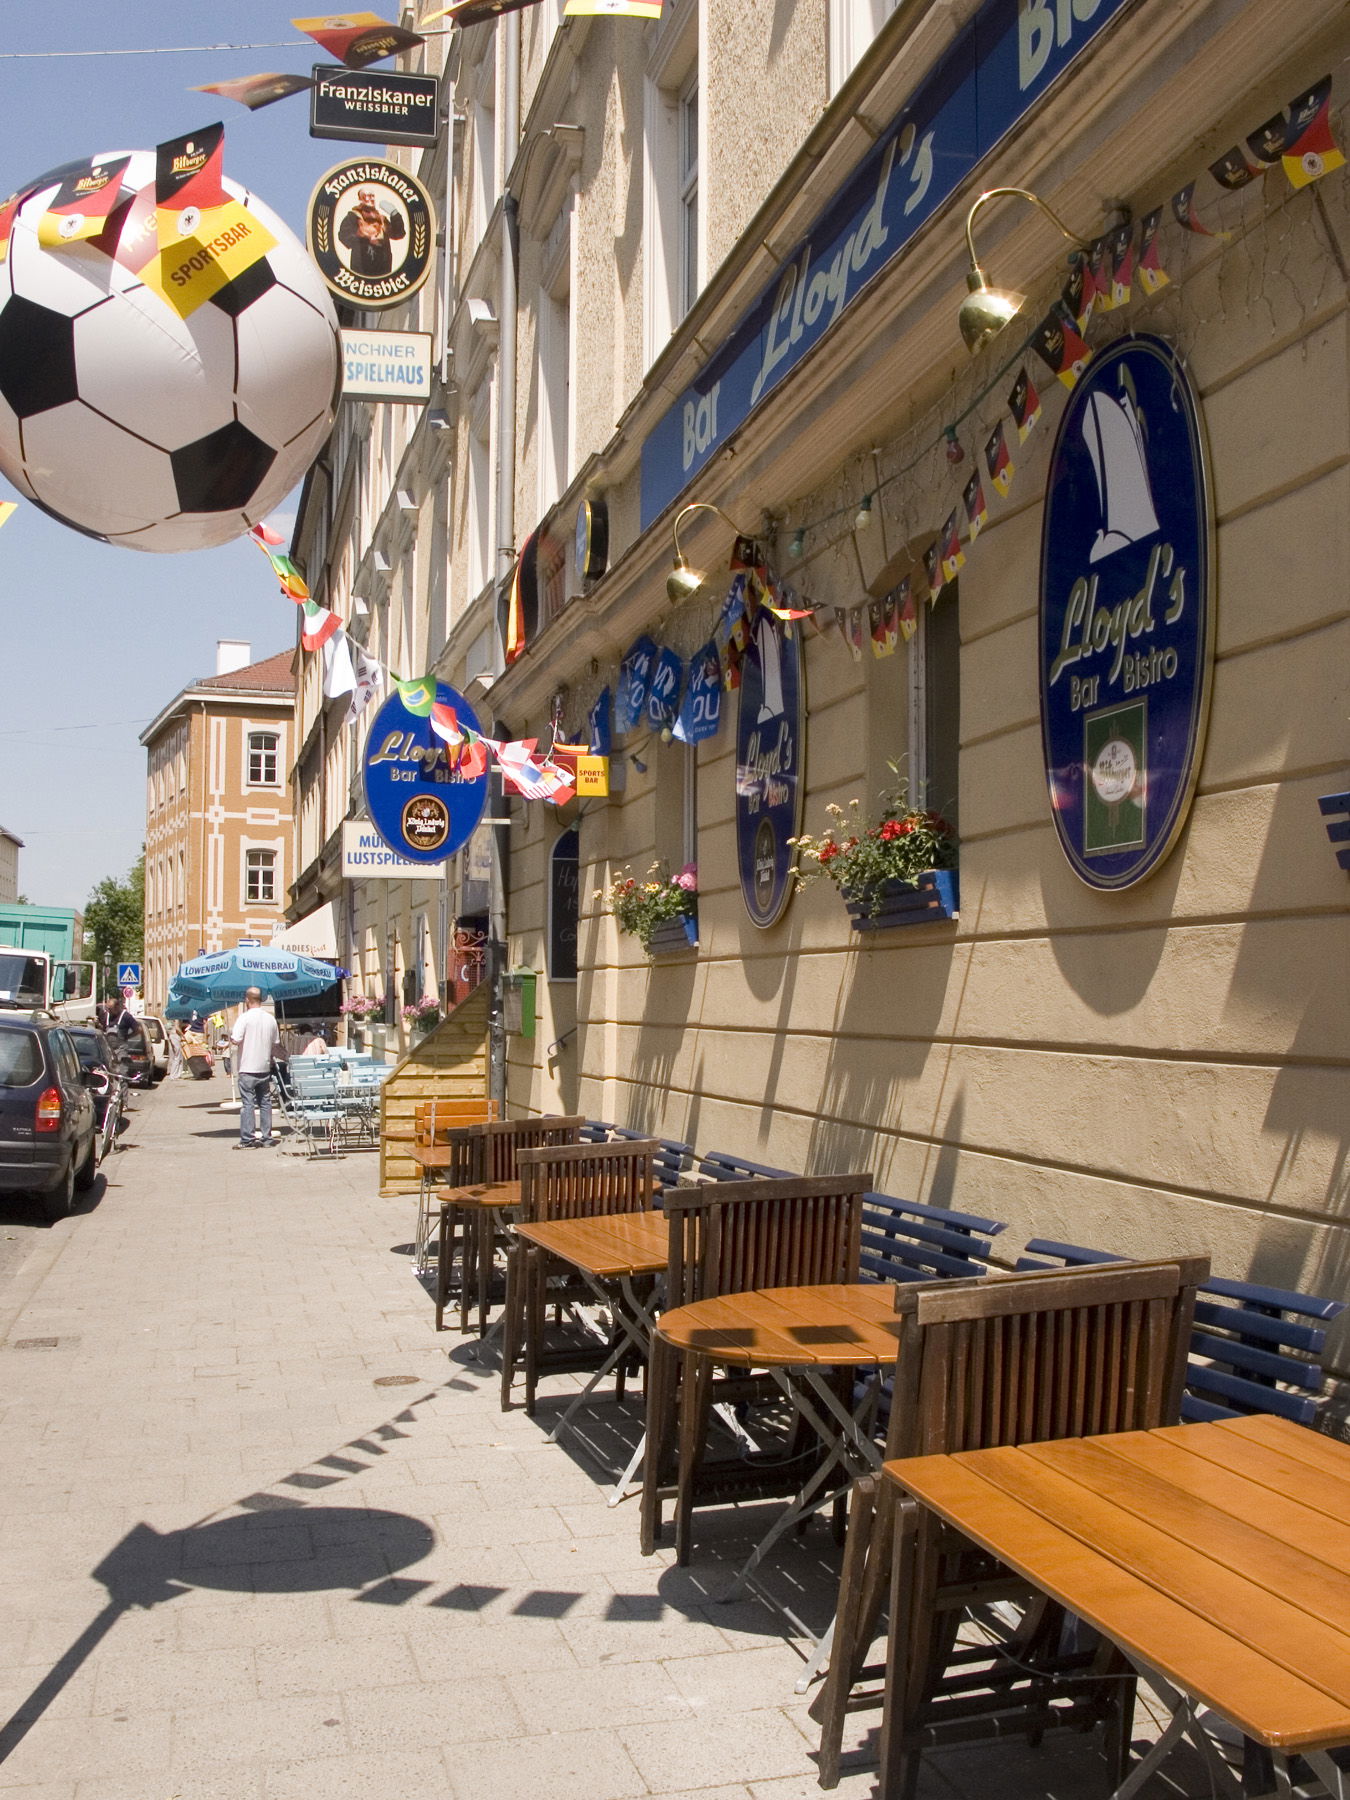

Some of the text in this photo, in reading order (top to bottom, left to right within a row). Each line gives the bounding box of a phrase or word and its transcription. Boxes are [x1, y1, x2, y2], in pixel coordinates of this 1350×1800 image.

[320, 82, 434, 107] Franziskaner
[344, 101, 409, 115] WEISSBIER
[324, 164, 419, 203] Franziskaner
[171, 222, 252, 287] SPORTSBAR
[334, 267, 411, 297] Weissbier
[683, 379, 721, 472] Bar
[751, 122, 934, 406] Lloyd's
[345, 342, 416, 358] NCHNER
[345, 361, 424, 385] SPIELHAUS
[1050, 542, 1186, 687] Lloyd's
[1071, 646, 1178, 713] Bar Bistro
[390, 767, 418, 782] Bar
[578, 769, 605, 777] SPORTS
[584, 776, 599, 784] BAR
[281, 944, 310, 953] LADIES
